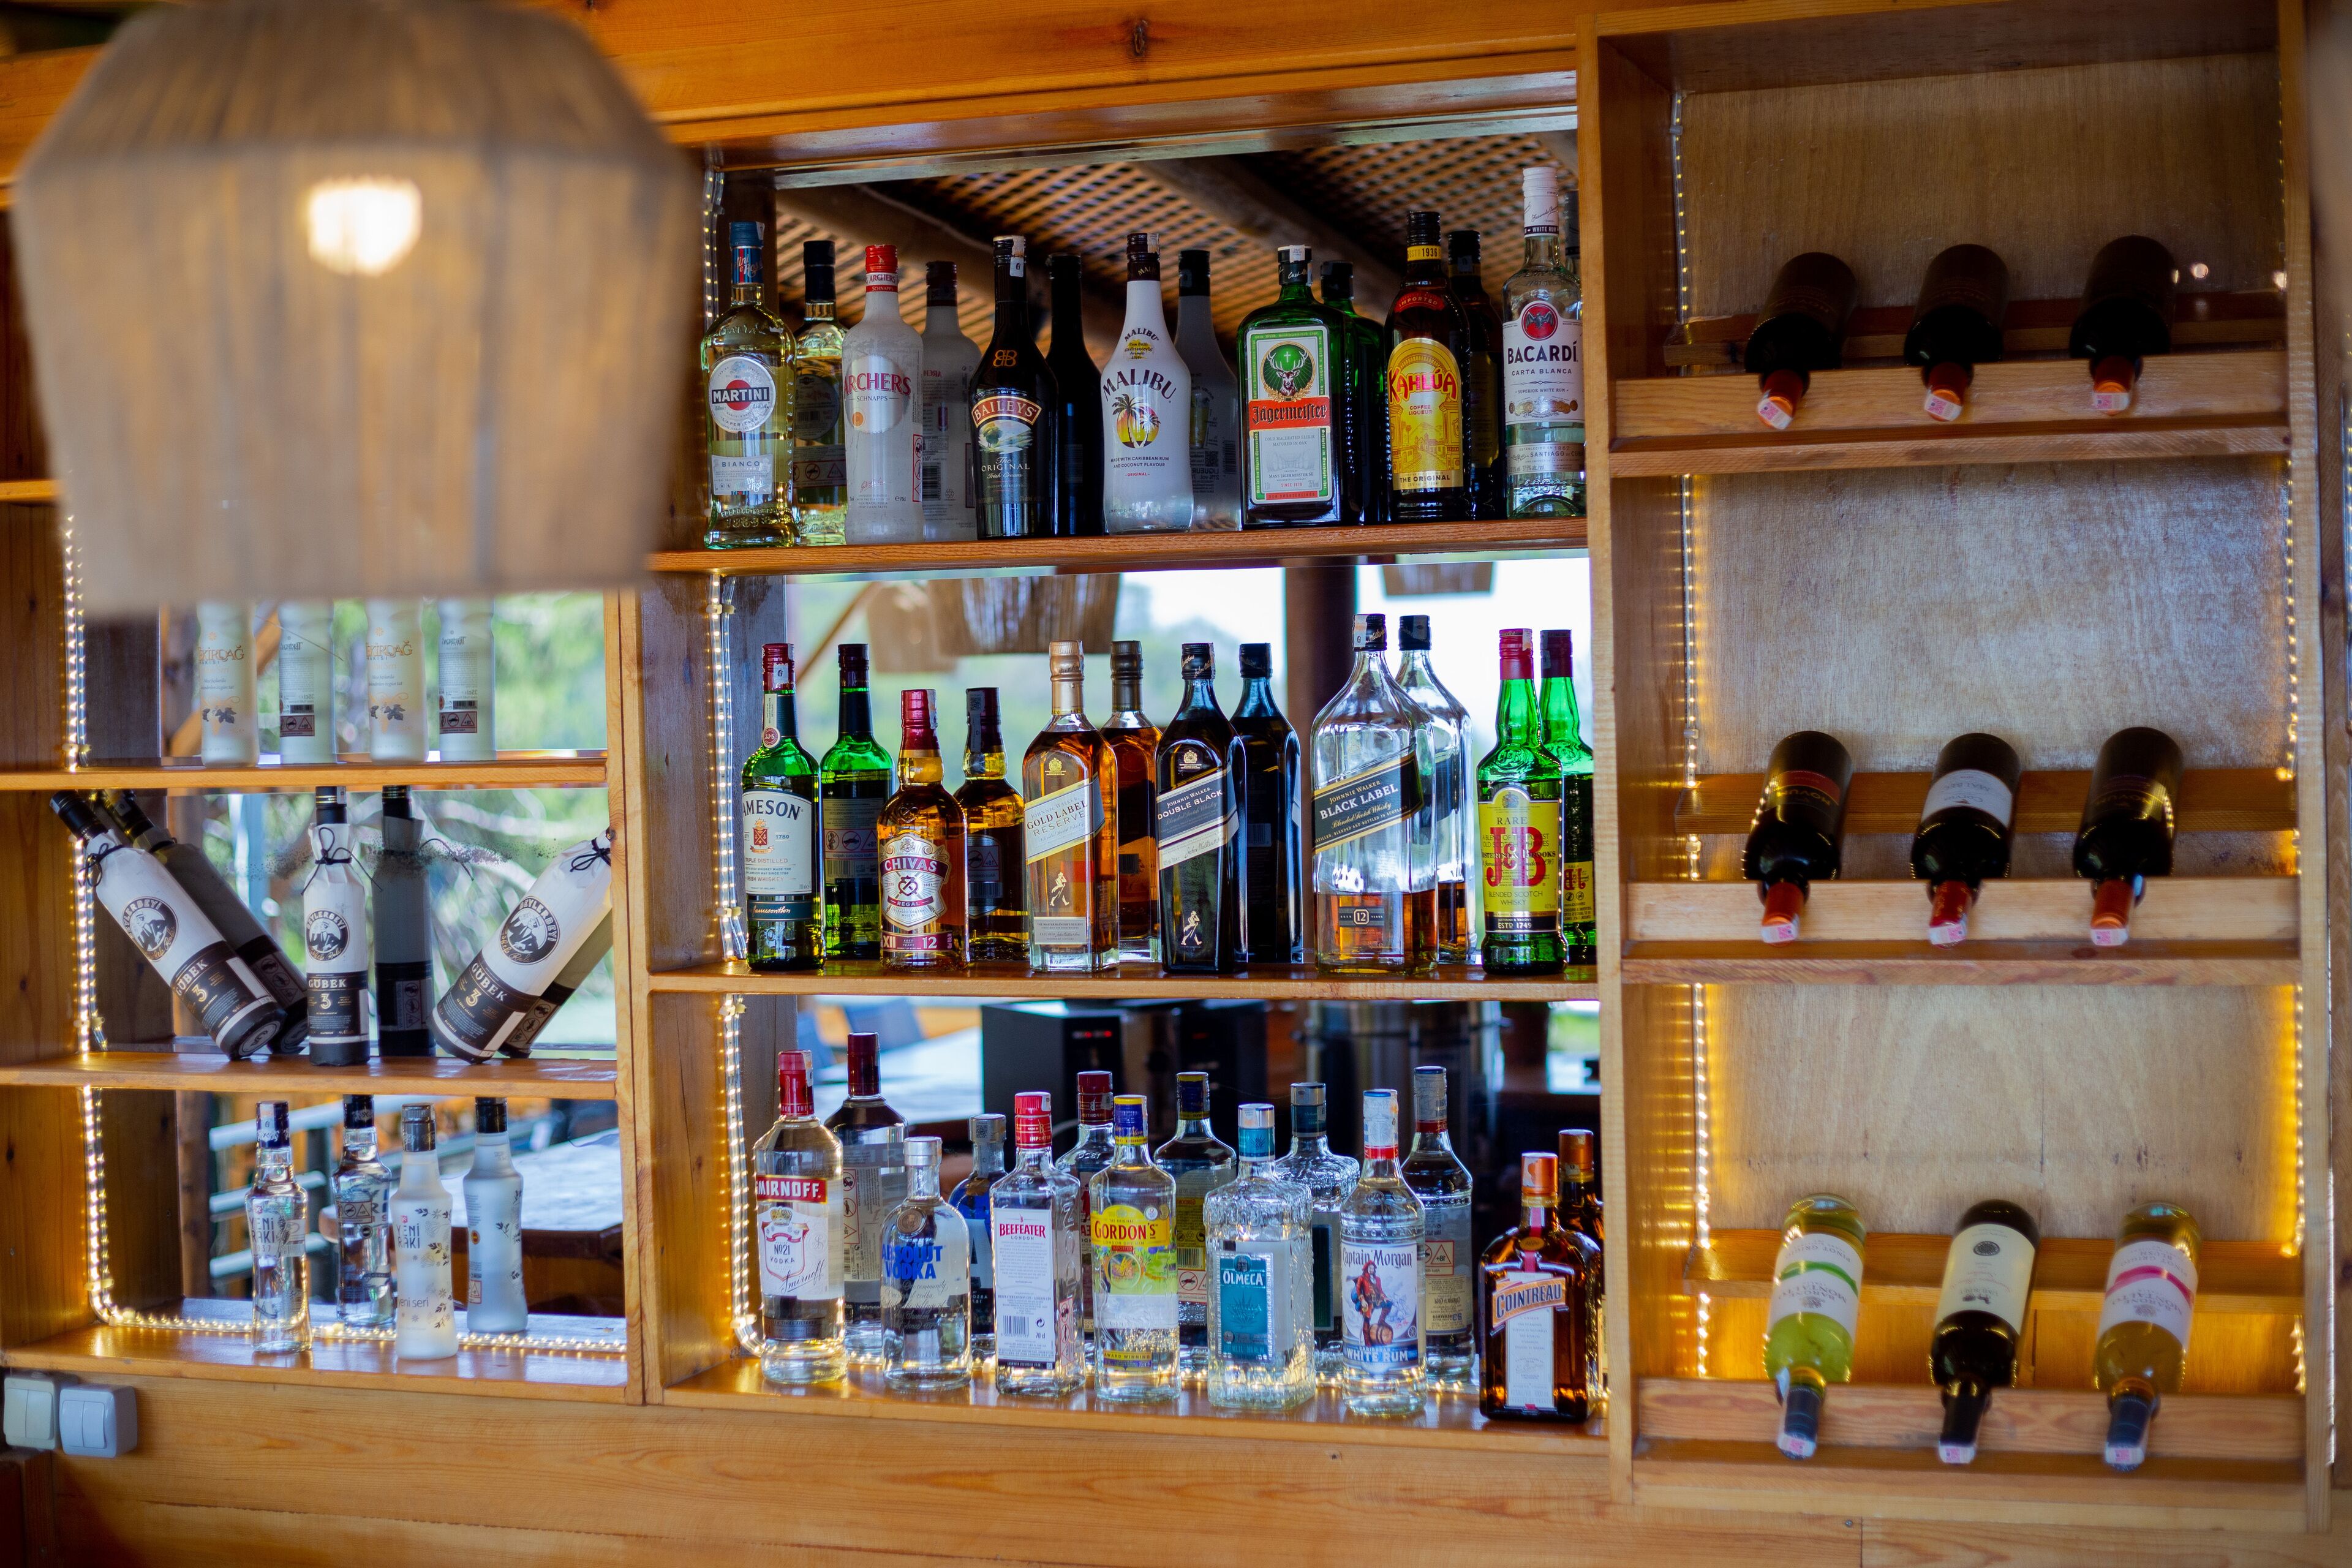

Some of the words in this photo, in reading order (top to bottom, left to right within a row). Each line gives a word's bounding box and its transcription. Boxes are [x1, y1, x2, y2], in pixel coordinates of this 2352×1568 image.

[1422, 248, 1438, 257] 1936
[869, 274, 896, 284] ARCHERS
[1399, 296, 1438, 307] IMPORTED
[1124, 328, 1158, 342] MALIBU
[1507, 340, 1577, 364] BACARDÍ
[843, 372, 911, 396] ARCHERS
[1102, 368, 1177, 402] MALIBU
[1389, 368, 1457, 403] KAHLÚA
[713, 388, 767, 403] MARTINI
[974, 401, 1033, 421] BAILEYS
[981, 463, 1030, 472] ORIGINAL
[198, 644, 244, 662] EKİRDAĞ
[366, 639, 413, 658] EKİRDAĞ
[1157, 801, 1192, 821] DOUBLE
[1194, 789, 1224, 805] BLACK
[1167, 796, 1190, 809] JOHNNIE
[1319, 797, 1359, 820] BLACK
[1359, 783, 1399, 805] LABEL
[1329, 790, 1356, 805] JOHNNIE
[1027, 813, 1054, 830] GOLD
[1055, 799, 1088, 819] LABEL
[1030, 806, 1055, 819] JOHNNIE
[1331, 815, 1355, 829] Blended
[1354, 810, 1371, 821] Scotch
[1371, 802, 1392, 814] Whisky
[1496, 816, 1528, 825] RARE
[1033, 810, 1085, 837] RESERVE
[1334, 826, 1352, 836] BLENDED
[1362, 816, 1379, 825] BOTTLED
[884, 857, 937, 873] CHIVAS
[1486, 827, 1547, 888] J&B
[1356, 912, 1366, 922] 12
[883, 935, 896, 949] XII
[922, 936, 937, 949] 12
[175, 959, 209, 997] GÖBEK
[308, 978, 347, 989] GÖBEK
[471, 962, 509, 1003] GÖBEK
[192, 983, 208, 1003] 3
[319, 993, 331, 1009] 3
[466, 987, 482, 1007] 3
[999, 1223, 1046, 1238] BEEFEATER
[1094, 1220, 1156, 1240] GORDON'S
[398, 1237, 420, 1248] RAKI
[881, 1244, 943, 1263] ABSOLUT
[1343, 1246, 1370, 1267] Captain
[1373, 1249, 1414, 1270] Morgan
[780, 1259, 826, 1295] Smirnoff
[884, 1263, 937, 1280] VODKA
[1223, 1270, 1264, 1286] OLMECA
[412, 1297, 429, 1308] seri
[1496, 1283, 1562, 1319] COINTREAU
[1104, 1352, 1125, 1360] AWARD
[1126, 1351, 1152, 1360] WINNING
[1347, 1349, 1378, 1362] WHITE
[1383, 1350, 1409, 1362] RUM
